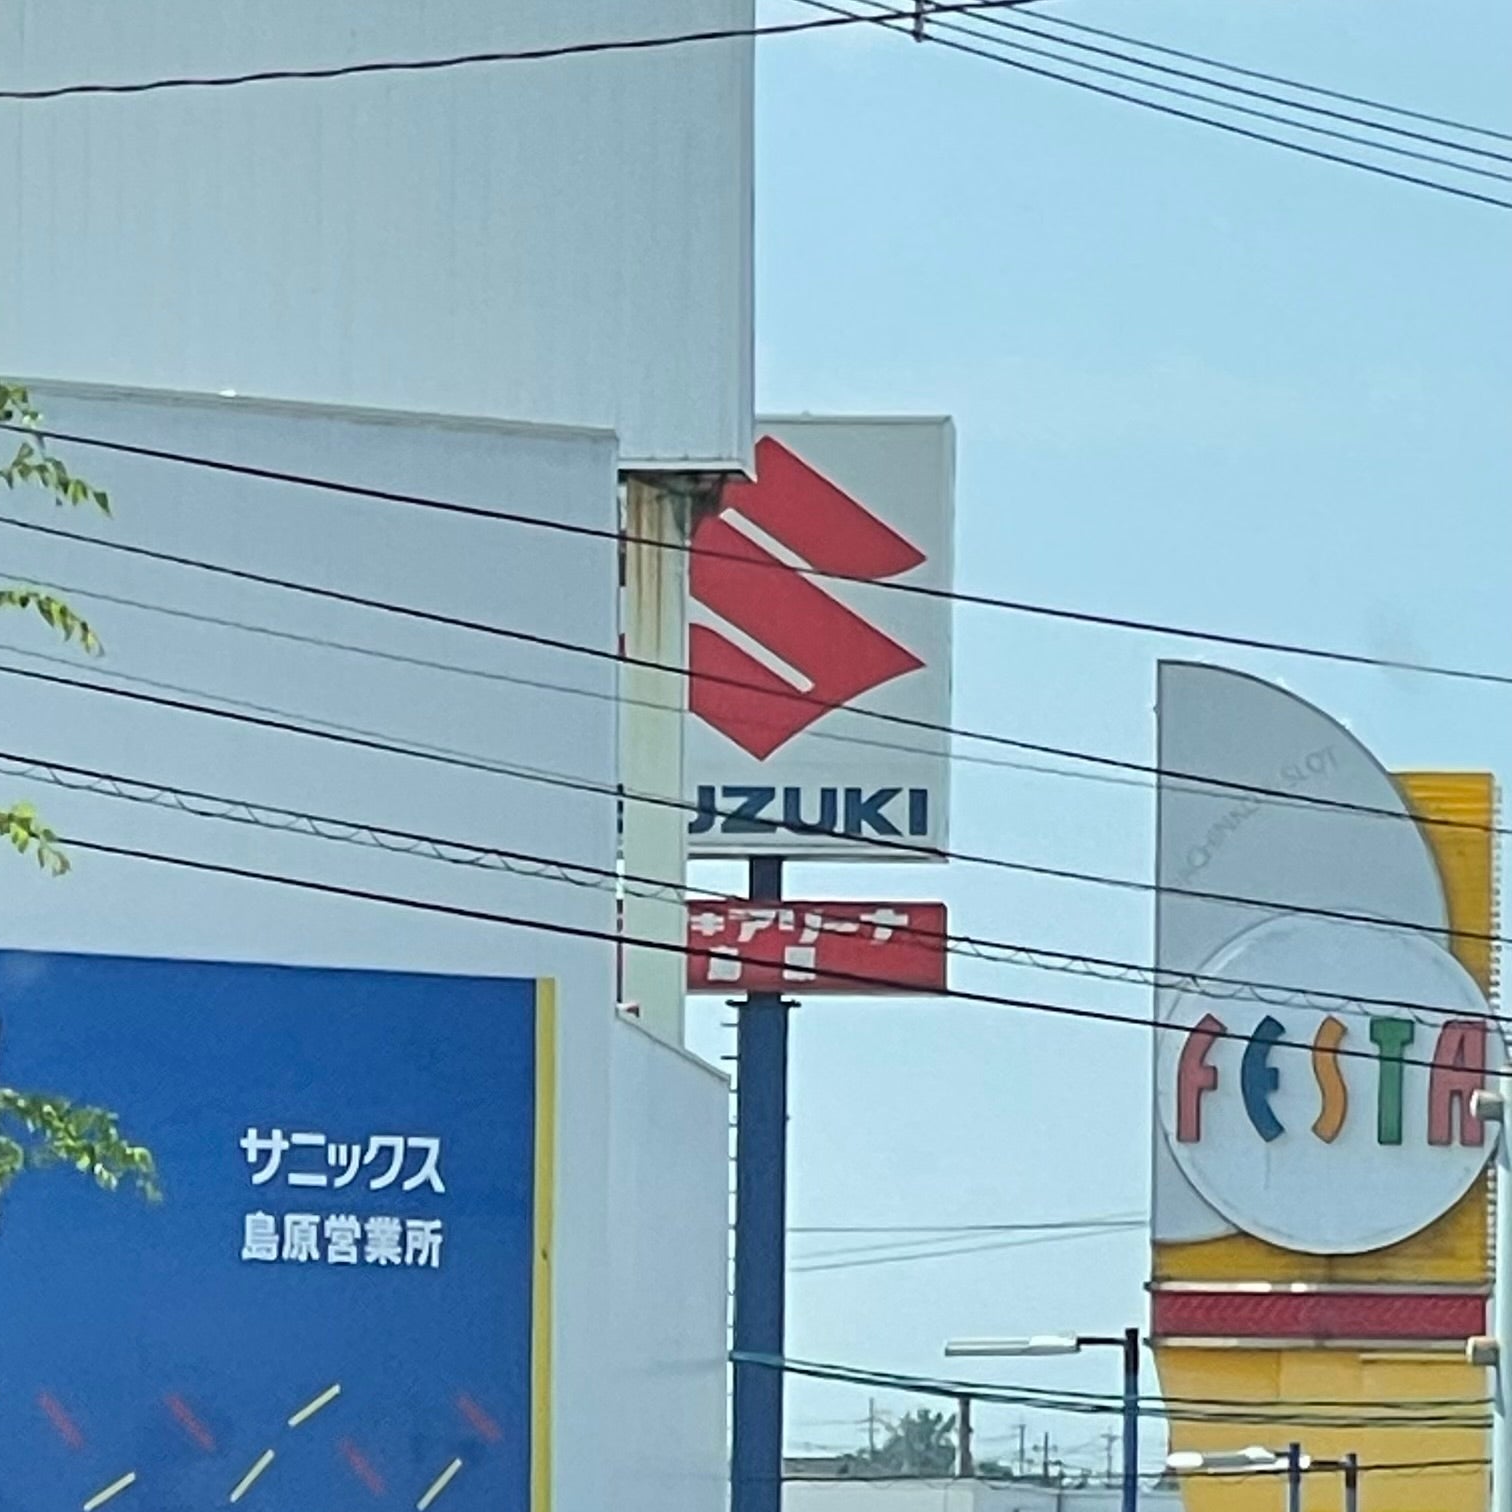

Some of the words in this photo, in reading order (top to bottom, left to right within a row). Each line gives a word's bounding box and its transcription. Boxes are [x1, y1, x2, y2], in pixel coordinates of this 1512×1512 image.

[688, 785, 929, 837] ZUKI
[690, 908, 909, 944] キアリーナ
[1176, 1013, 1486, 1146] FESTA
[240, 1127, 446, 1193] サニックス
[241, 1210, 443, 1268] 島原営業所
